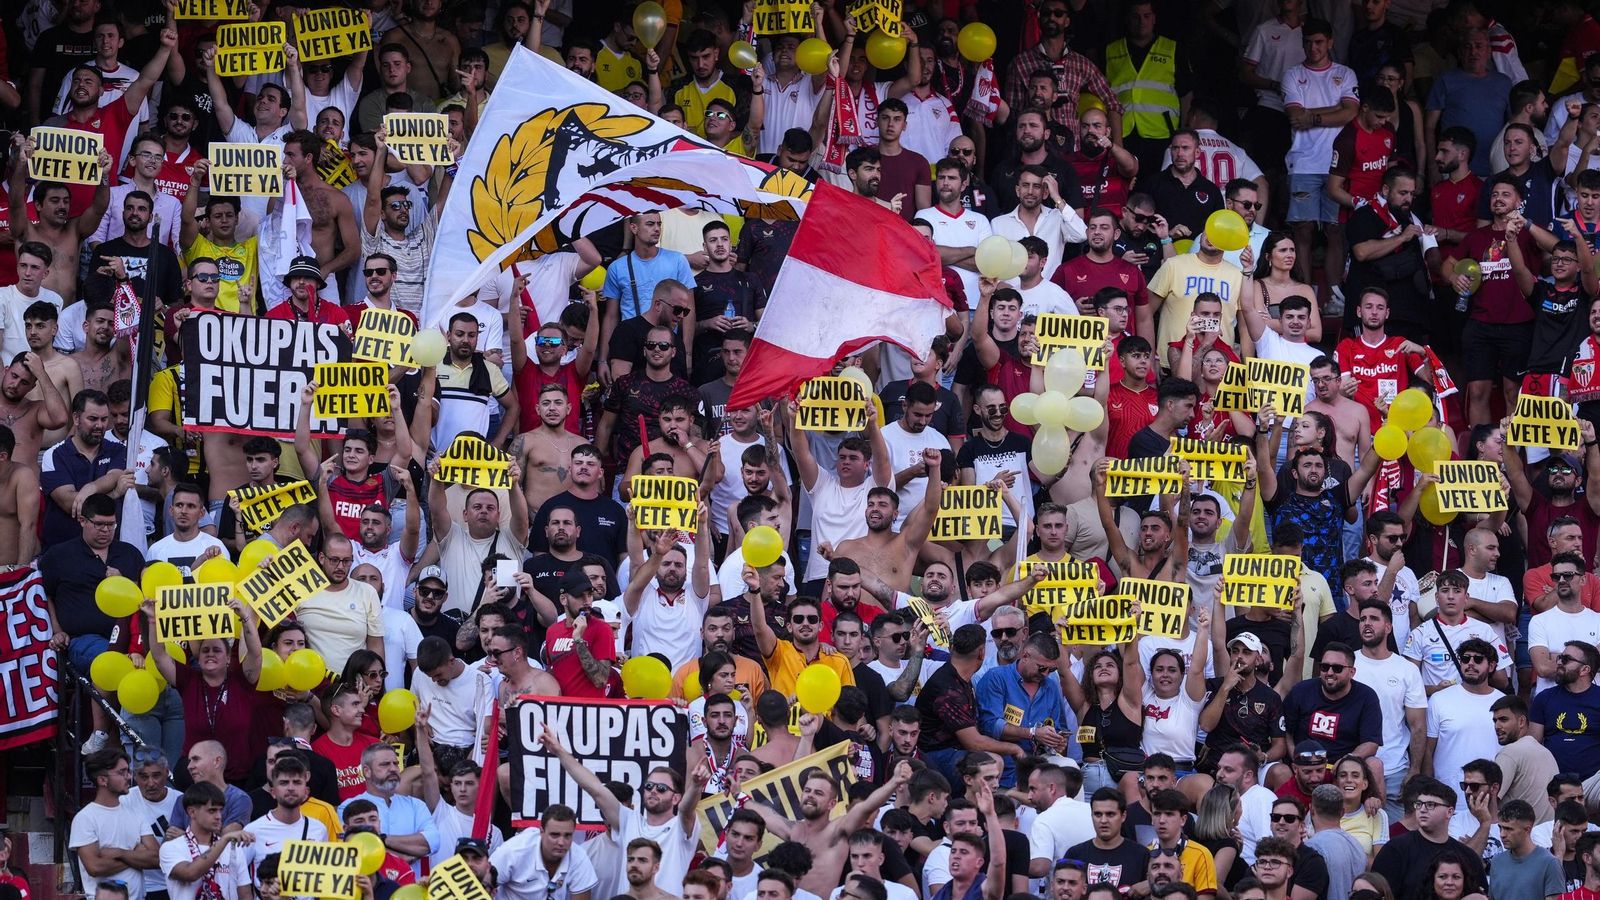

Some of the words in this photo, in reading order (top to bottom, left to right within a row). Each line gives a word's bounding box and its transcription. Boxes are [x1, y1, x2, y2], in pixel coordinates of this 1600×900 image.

[178, 0, 218, 16] VETE
[227, 0, 248, 16] YA
[299, 8, 363, 35] JUNIOR
[757, 11, 788, 31] VETE
[792, 9, 813, 31] YA
[219, 25, 282, 48] JUNIOR
[300, 34, 344, 60] VETE
[348, 30, 370, 51] YA
[217, 51, 260, 74] VETE
[263, 50, 284, 70] YA
[387, 119, 446, 139] JUNIOR
[34, 132, 99, 157] JUNIOR
[430, 144, 451, 162] YA
[32, 156, 73, 179] VETE
[77, 161, 99, 182] YA
[214, 148, 278, 169] JUNIOR
[212, 173, 257, 194] VETE
[259, 174, 280, 194] YA
[1184, 276, 1230, 302] POLO
[1039, 316, 1105, 341] JUNIOR
[199, 313, 339, 370] OKUPAS
[354, 337, 397, 361] VETE
[1083, 345, 1104, 367] YA
[318, 366, 385, 388] JUNIOR
[1352, 363, 1398, 377] Playtika
[199, 364, 339, 431] FUER
[801, 381, 864, 401] JUNIOR
[317, 394, 362, 414] VETE
[365, 393, 389, 414] YA
[1283, 392, 1303, 414] YA
[799, 406, 843, 429] VETE
[845, 406, 868, 428] YA
[1510, 423, 1552, 444] VETE
[1556, 426, 1579, 447] YA
[1110, 457, 1179, 472] JUNIOR
[1188, 460, 1218, 479] ETE
[1221, 461, 1245, 481] YA
[1439, 463, 1499, 484] JUNIOR
[437, 465, 486, 483] VETE
[488, 468, 511, 488] YA
[1109, 475, 1151, 496] VETE
[1158, 475, 1181, 494] YA
[632, 478, 698, 501] JUNIOR
[940, 489, 998, 510] UNIOR
[1439, 488, 1477, 509] VETE
[1480, 488, 1506, 508] YA
[241, 500, 287, 530] VETE
[290, 483, 315, 506] YA
[678, 508, 698, 530] YA
[930, 515, 975, 537] VETE
[979, 515, 1001, 536] YA
[243, 546, 309, 602] JUNIOR
[1026, 562, 1094, 581] JNIOR
[1227, 557, 1297, 579] JUNIOR
[159, 586, 230, 611] JUNIOR
[258, 586, 300, 623] VETE
[298, 568, 328, 597] YA
[1025, 588, 1065, 605] VETE
[1074, 586, 1097, 601] YA
[1225, 582, 1267, 604] VETE
[1273, 583, 1295, 606] YA
[1065, 598, 1132, 621] JUNIOR
[158, 614, 201, 639] VETE
[208, 612, 233, 635] YA
[1064, 625, 1107, 643] VETE
[1110, 623, 1134, 642] YA
[1161, 613, 1181, 635] YA
[552, 637, 574, 652] NIKE
[519, 701, 677, 758] OKUPAS
[522, 755, 672, 821] FUER
[285, 844, 357, 867] JUNIOR
[280, 871, 323, 893] VETE
[332, 874, 354, 897] YA
